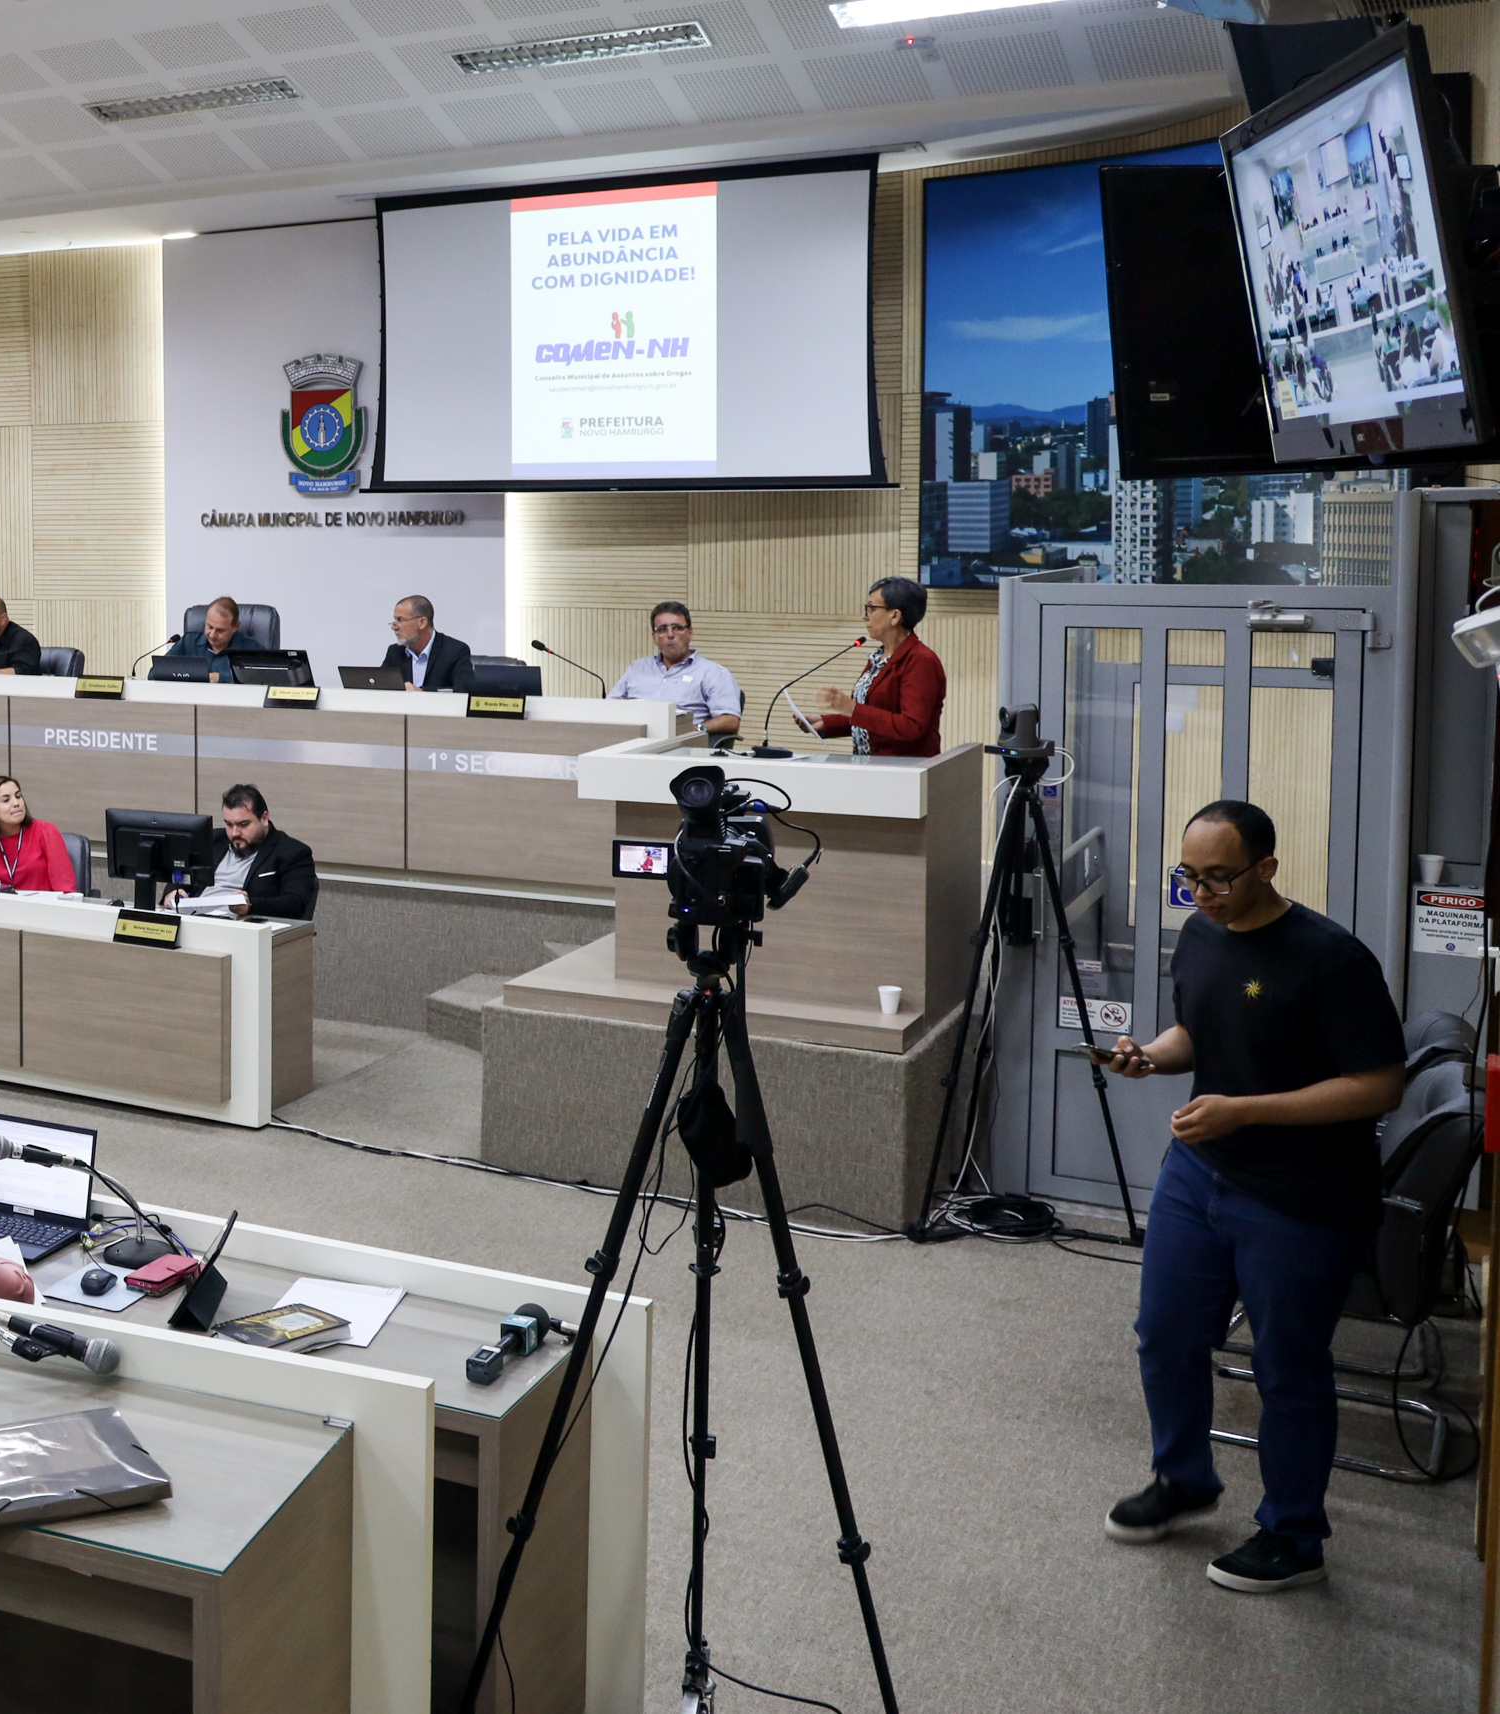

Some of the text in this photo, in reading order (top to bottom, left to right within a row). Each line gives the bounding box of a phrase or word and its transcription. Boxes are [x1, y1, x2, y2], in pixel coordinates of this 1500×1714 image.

[547, 223, 678, 247] PELA VIDA EM
[547, 245, 679, 268] ABUNDÂNCIA
[531, 266, 696, 290] COM DIGNIDADE!
[534, 374, 566, 382] Conselho
[567, 372, 600, 381] Municipal
[612, 371, 644, 379] Assuntos
[666, 369, 692, 377] Drogas
[579, 416, 664, 428] PREFEITURA
[579, 427, 665, 437] NOVO HAMBURGO
[200, 509, 465, 528] CÂMARA MUNICIPAL DE NOVO HAMBURGO
[43, 728, 158, 751] PRESIDENTE
[1430, 895, 1477, 907] PERIGO
[1426, 910, 1478, 921] MAQUINARIA
[1431, 918, 1485, 929] PLATAFORMA
[1063, 999, 1092, 1008] ATENO
